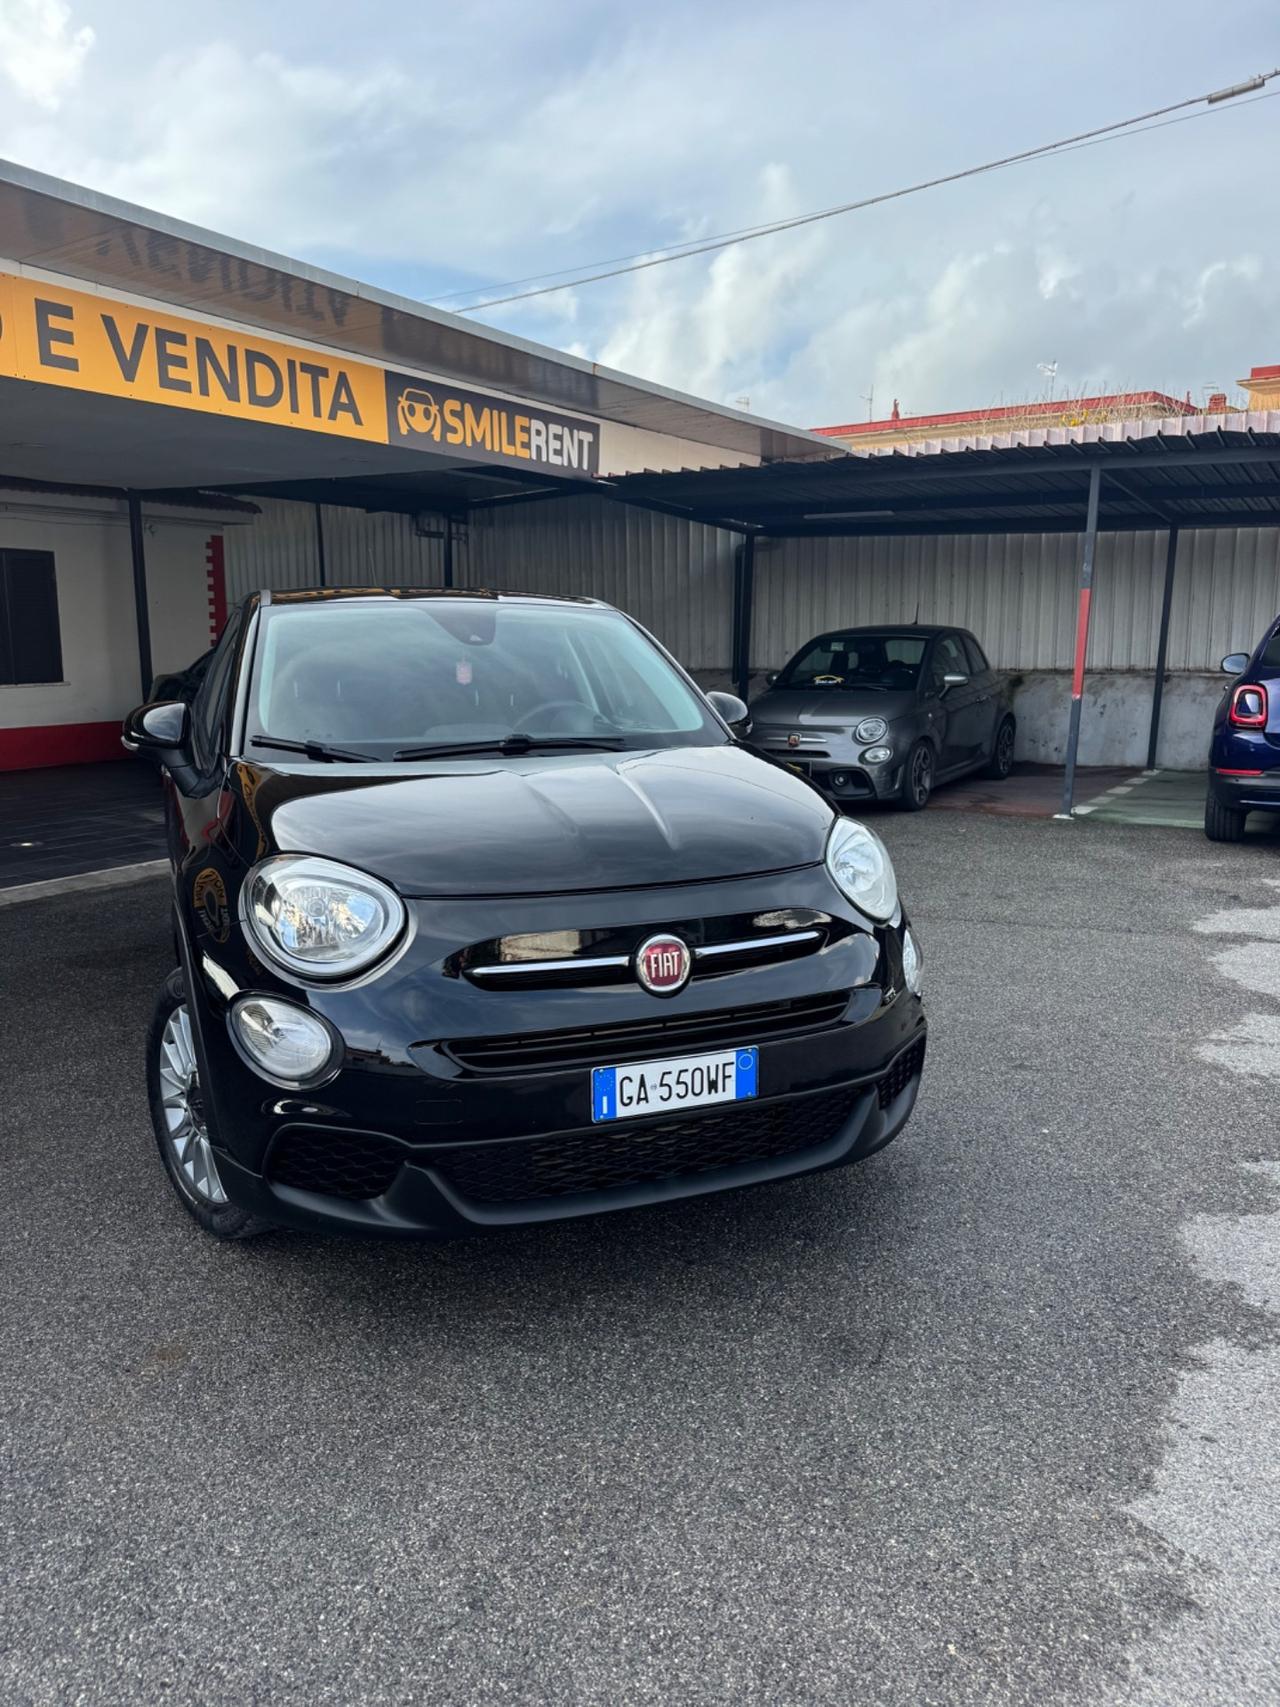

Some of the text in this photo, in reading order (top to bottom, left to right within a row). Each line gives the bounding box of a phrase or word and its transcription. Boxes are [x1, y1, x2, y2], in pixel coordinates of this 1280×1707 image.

[34, 297, 79, 372] E
[100, 313, 364, 426] VENDITA
[443, 399, 594, 471] SMILERENT
[650, 951, 680, 978] FIAT
